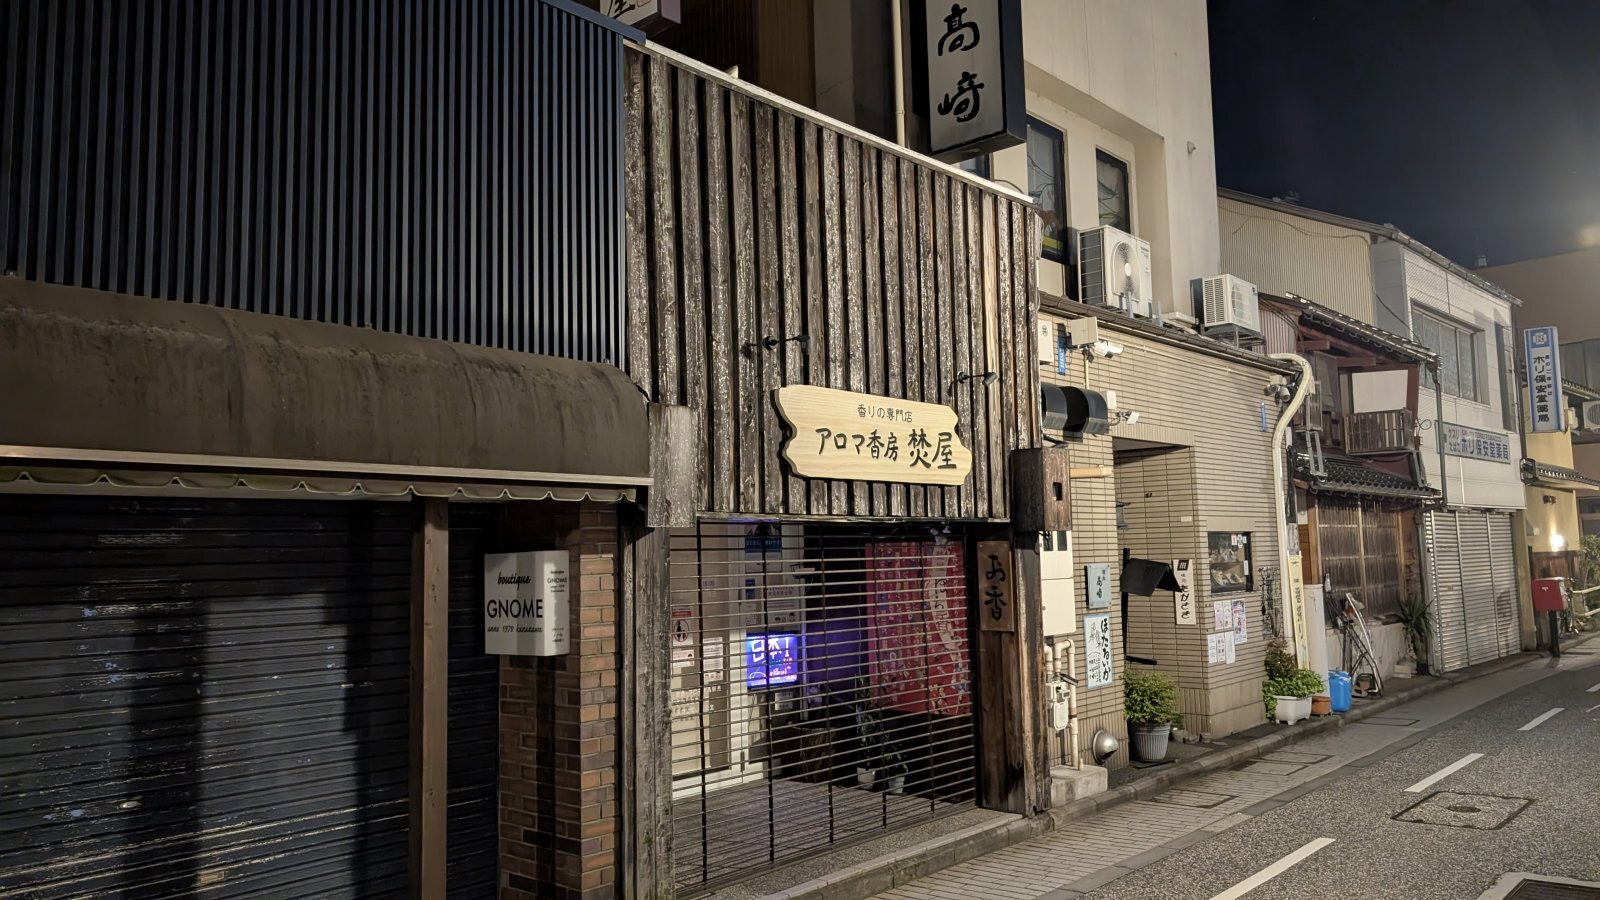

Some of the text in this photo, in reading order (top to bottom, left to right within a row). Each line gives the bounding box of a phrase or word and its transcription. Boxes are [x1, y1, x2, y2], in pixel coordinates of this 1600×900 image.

[1533, 356, 1550, 423] ホリ保安堂薬局
[857, 404, 913, 423] 香りの専門店
[815, 427, 957, 469] アロマ香房 焚屋
[497, 572, 531, 591] boutique
[984, 553, 1009, 621] お香
[486, 599, 543, 619] GNOME
